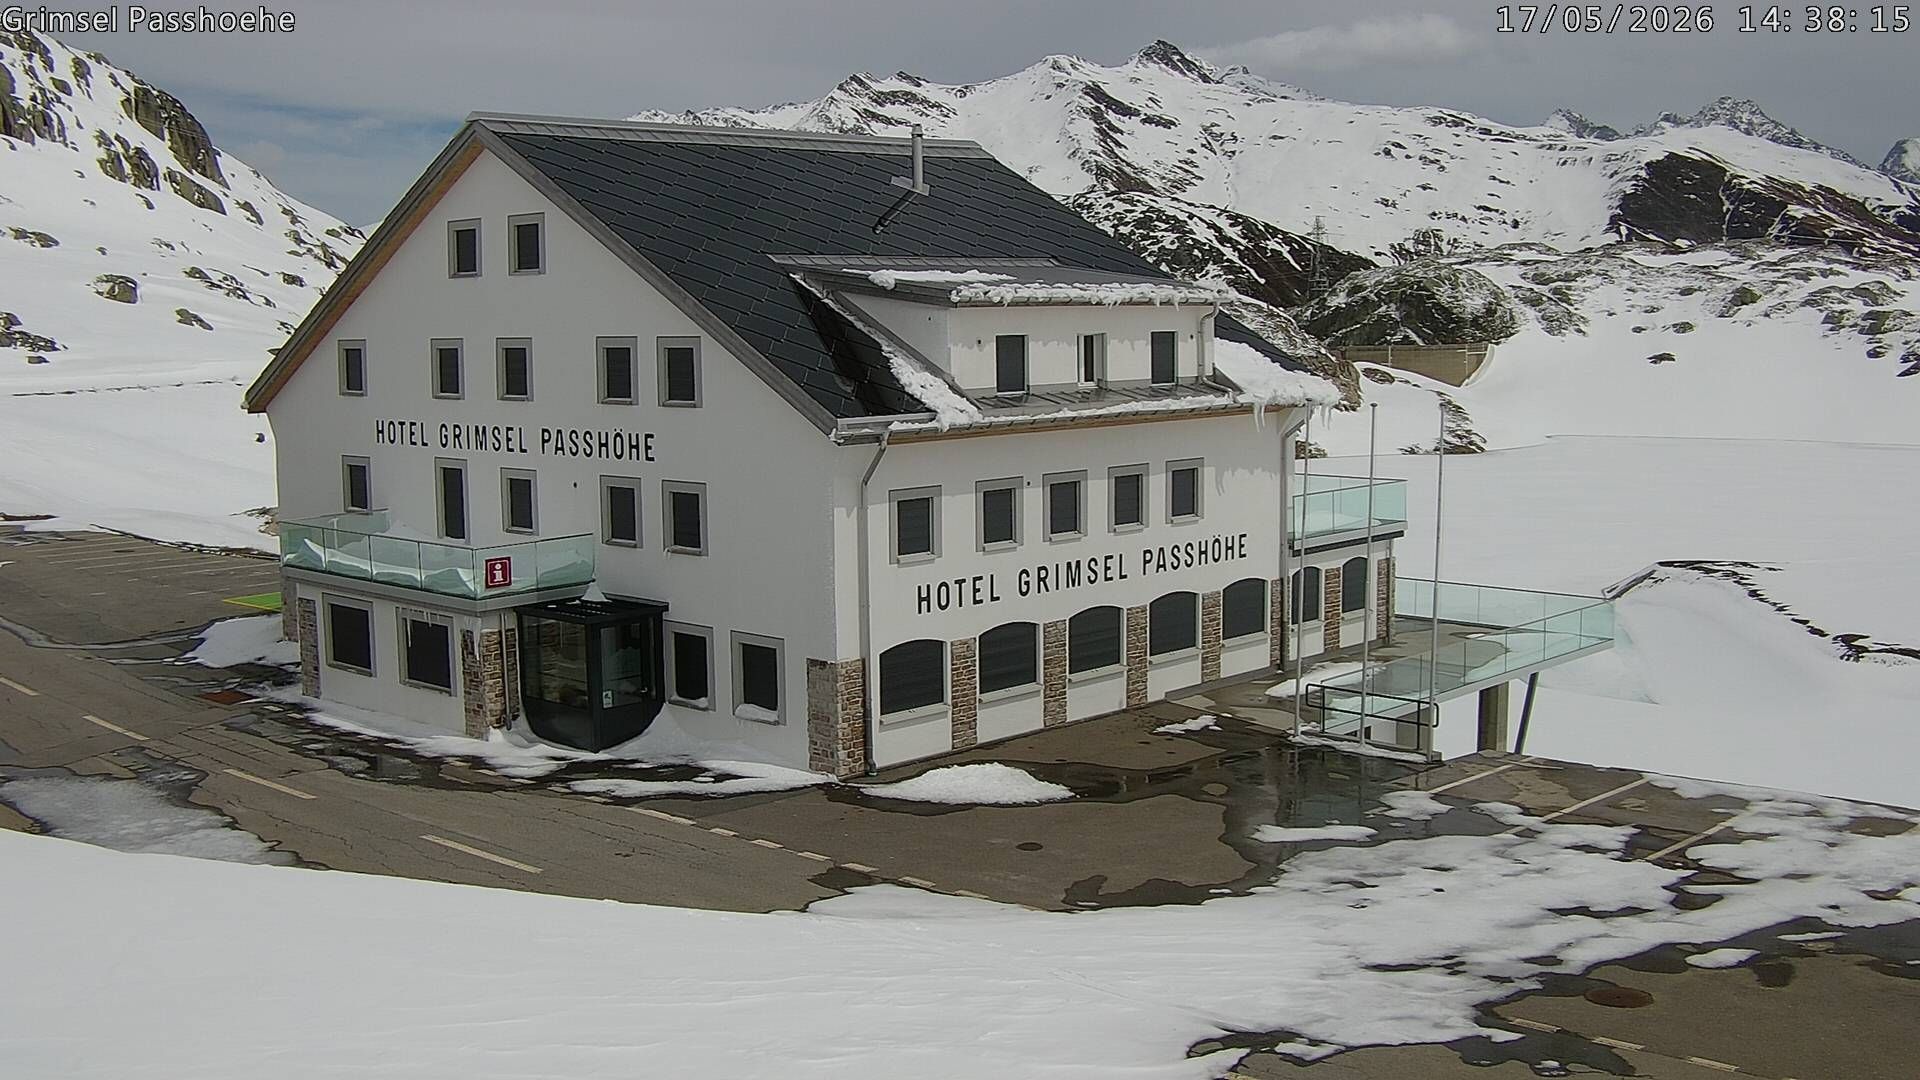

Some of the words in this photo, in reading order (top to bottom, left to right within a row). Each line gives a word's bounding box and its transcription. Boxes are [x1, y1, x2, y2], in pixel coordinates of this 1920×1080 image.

[375, 419, 429, 447] HOTEL
[439, 423, 528, 454] GRIMSEL
[541, 428, 656, 462] PASSHÖHE
[917, 574, 1001, 615] HOTEL
[1017, 553, 1128, 597] GRIMSEL
[1142, 533, 1248, 576] PASSHÖHE
